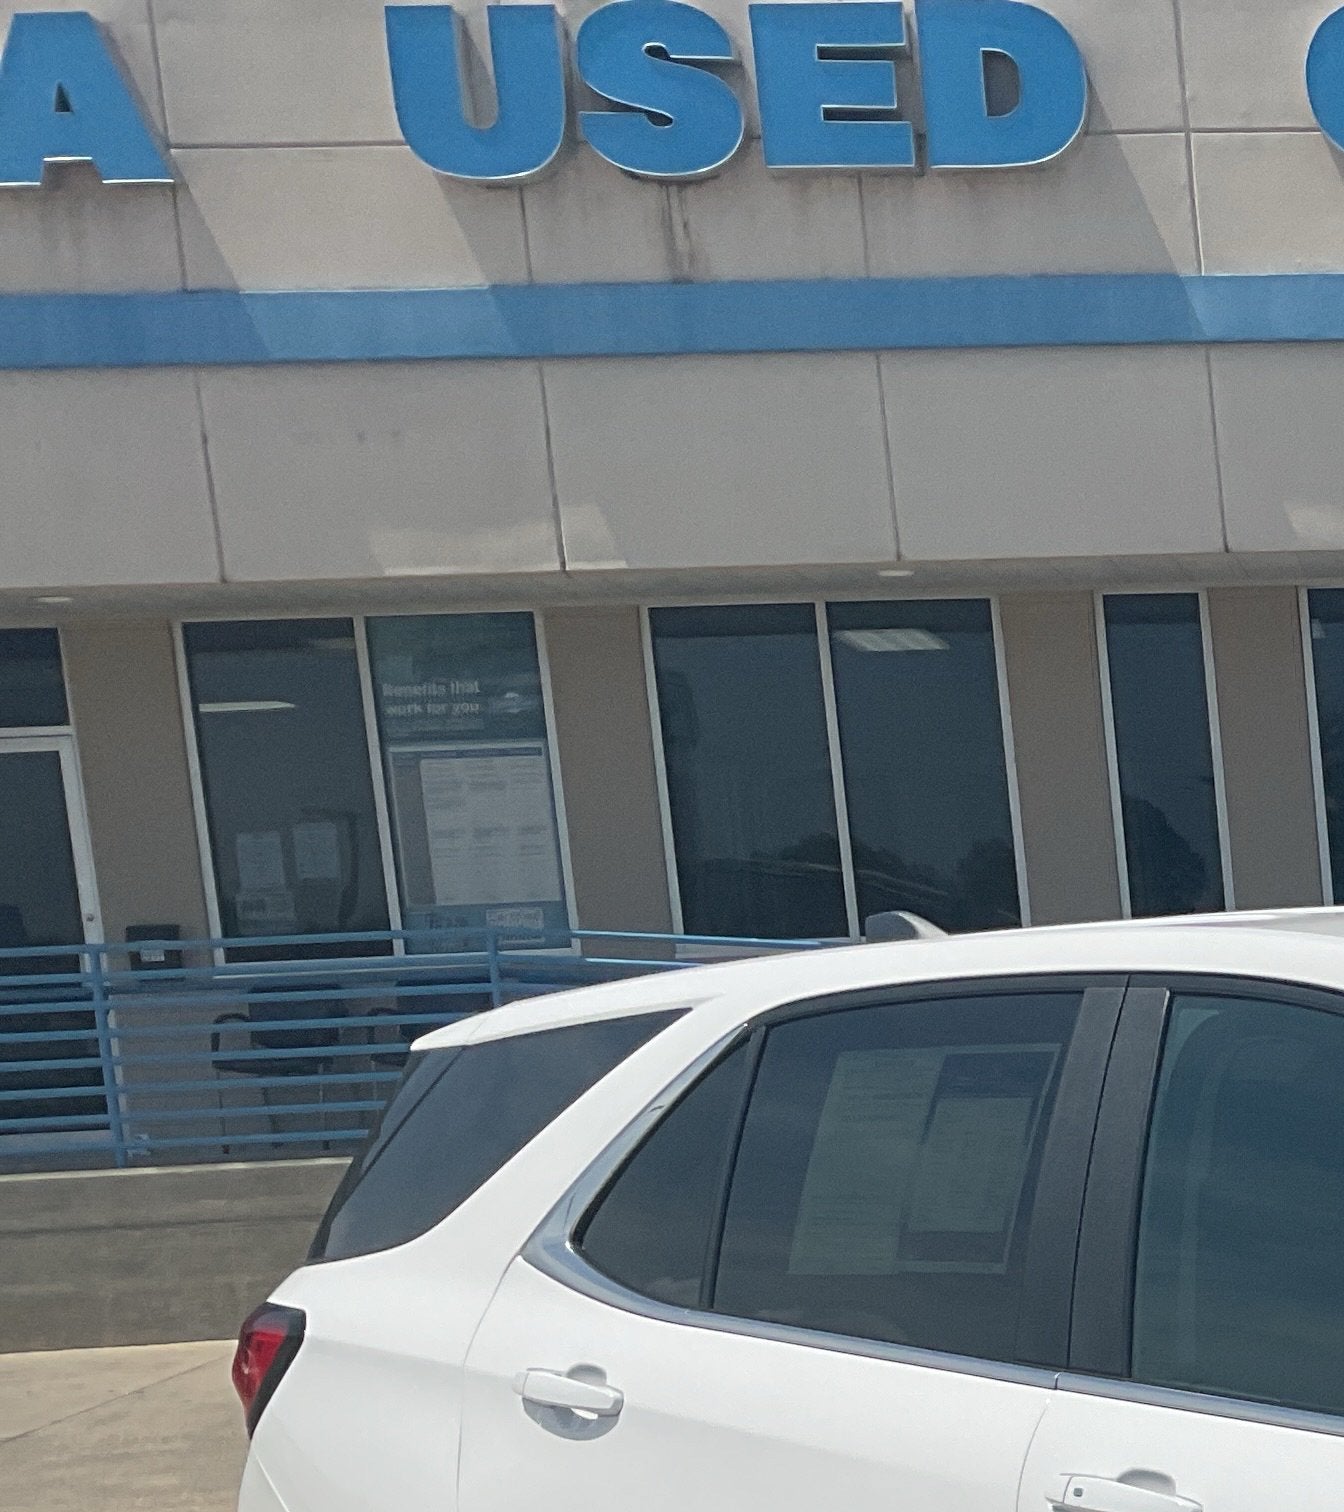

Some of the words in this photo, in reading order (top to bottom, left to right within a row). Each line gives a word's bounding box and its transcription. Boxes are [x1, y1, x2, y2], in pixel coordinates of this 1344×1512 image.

[384, 0, 1088, 181] USED
[450, 679, 481, 695] that
[385, 703, 423, 715] work
[451, 702, 480, 716] you
